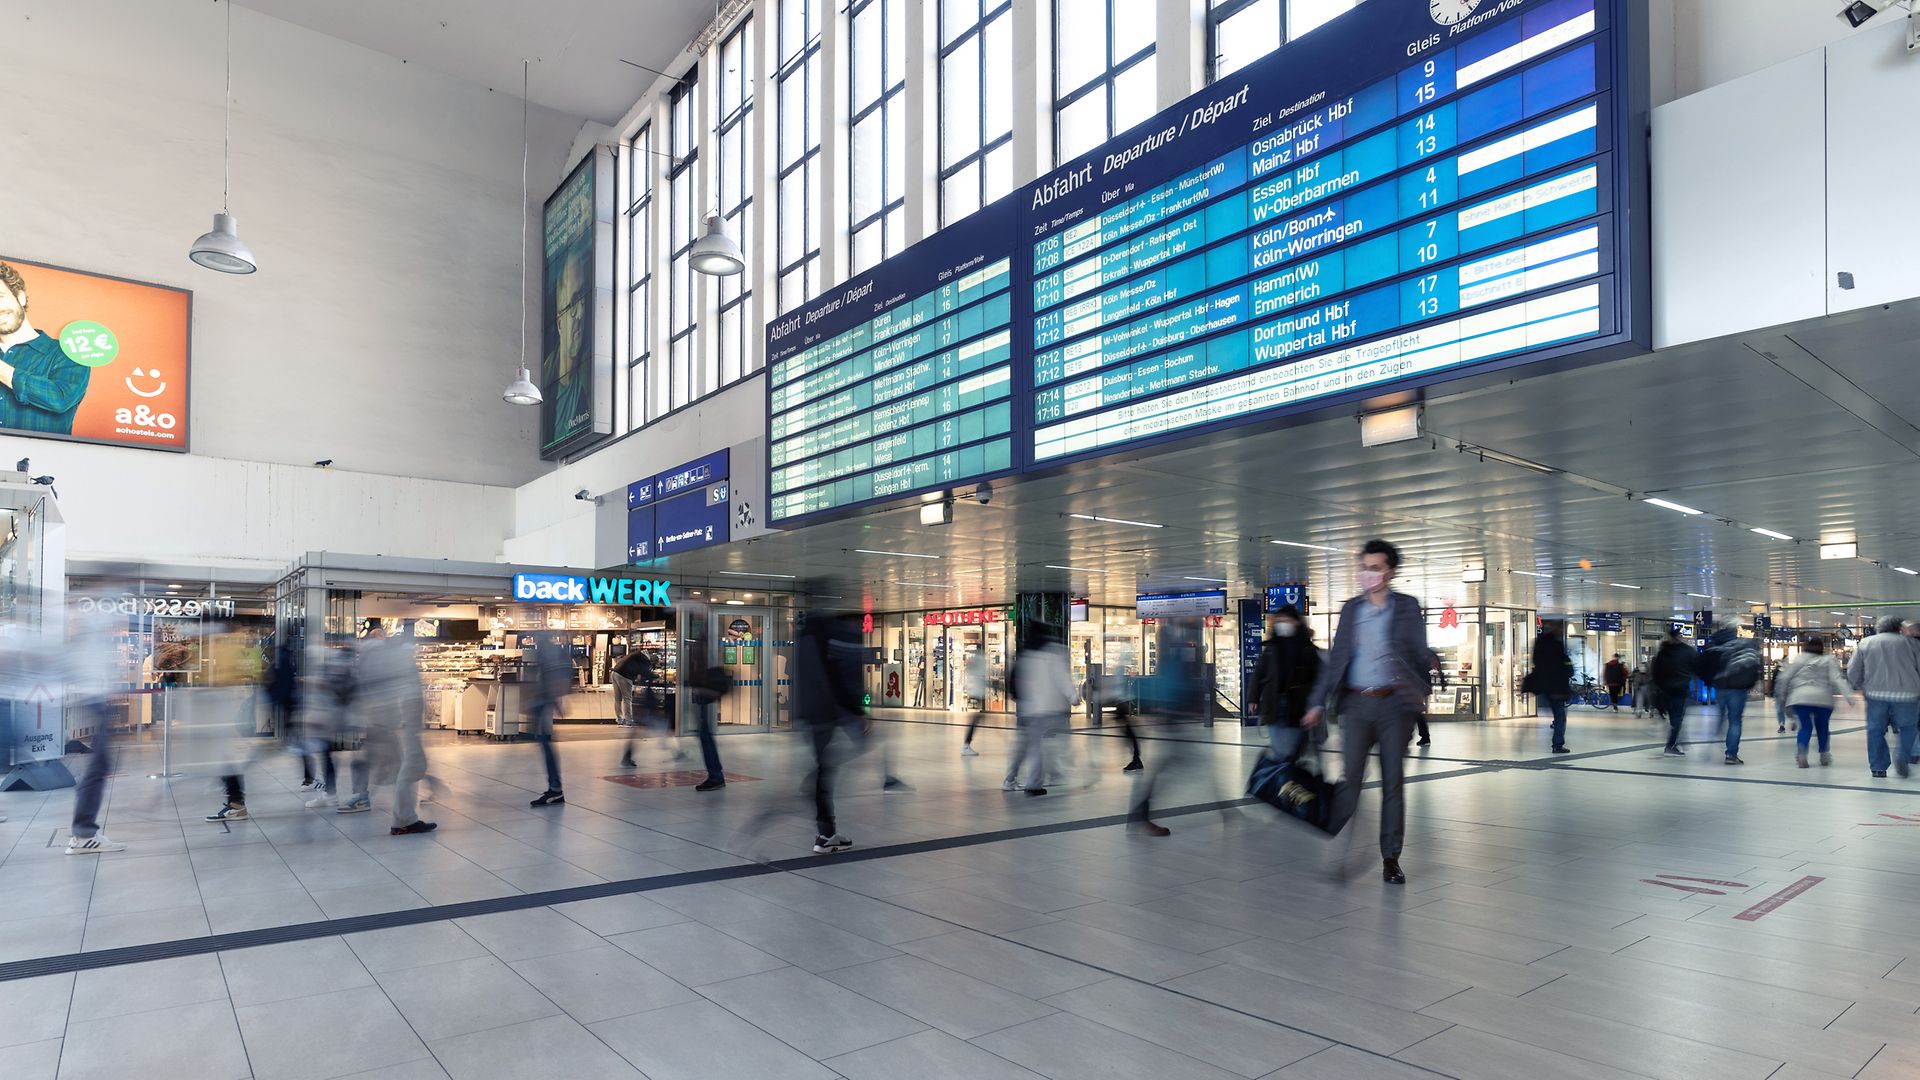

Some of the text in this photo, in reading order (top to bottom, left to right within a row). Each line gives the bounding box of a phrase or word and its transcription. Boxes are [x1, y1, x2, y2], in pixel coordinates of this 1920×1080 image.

[1406, 33, 1440, 58] Gleis
[1424, 59, 1434, 79] 9
[1414, 81, 1435, 105] 15
[1252, 90, 1325, 132] Ziel Destination
[1252, 97, 1352, 157] Osnabrück Hbf
[1415, 113, 1435, 136] 14
[1032, 163, 1091, 211] Abfahrt
[1102, 126, 1174, 175] Departure
[1191, 82, 1248, 129] Départ
[1253, 133, 1318, 176] Mainz Hbf
[1415, 135, 1436, 158] 13
[1253, 161, 1319, 203] Essen Hbf
[1425, 166, 1436, 185] 4
[1101, 187, 1120, 204] Über
[1102, 161, 1223, 226] Düsseldorf Essen Münster(W)
[1253, 169, 1359, 222] W-Oberbarmen
[1416, 188, 1437, 210] 11
[1103, 186, 1208, 242] Köln Messe/Dz Frankfurt(M)
[1034, 222, 1047, 236] Zeit
[1253, 213, 1322, 249] Köln/Bonn
[1426, 220, 1437, 238] 7
[1035, 235, 1058, 257] 17:06
[1103, 218, 1196, 266] D-Derendorf Ratingen Ost
[1253, 219, 1362, 268] Köln-Worringen
[1036, 251, 1058, 272] 17:08
[1103, 240, 1186, 282] Erkrath Wuppertal Hbf
[1417, 242, 1437, 264] 10
[938, 269, 952, 282] Gleis
[1036, 273, 1058, 294] 17:10
[1254, 259, 1318, 295] Hamm(W)
[1417, 273, 1438, 295] 17
[942, 285, 950, 298] 16
[1036, 289, 1058, 309] 17:10
[1103, 278, 1155, 305] Köln Messe/Dz
[1145, 293, 1161, 307] Köln
[1163, 286, 1176, 300] Hbf
[1255, 280, 1319, 314] Emmerich
[770, 279, 872, 342] Abfahrt Departure Départ
[942, 299, 950, 311] 16
[1417, 296, 1438, 317] 13
[942, 318, 950, 331] 11
[1036, 311, 1058, 331] 17:11
[1103, 293, 1239, 345] W-Vohwinkel Wuppertal Hbf Hagen
[1254, 299, 1349, 342] Dortmund Hbf
[64, 333, 112, 352] 12 €
[942, 332, 950, 345] 17
[1036, 327, 1059, 346] 17:12
[1103, 313, 1236, 362] Düsseldorf Duisburg Oberhausen
[1255, 318, 1356, 361] Wuppertal Hbf
[942, 352, 950, 365] 13
[1036, 349, 1059, 368] 17:12
[1318, 357, 1332, 369] Sie
[1355, 334, 1419, 360] Tragepflicht
[874, 372, 904, 389] Mettmann
[906, 363, 930, 378] Stadtw.
[942, 366, 950, 378] 14
[1036, 365, 1059, 383] 17:12
[1104, 353, 1193, 385] Duisburg Essen Bochum
[1150, 373, 1185, 389] Mettmann
[1189, 364, 1219, 379] Stadtw.
[1283, 380, 1319, 398] Bahnhof
[1323, 375, 1340, 388] und
[1357, 369, 1375, 380] den
[1379, 360, 1412, 375] Zügen
[874, 383, 902, 402] Dortmund
[904, 378, 915, 391] Hbf
[943, 386, 950, 398] 11
[1036, 387, 1059, 405] 17:14
[115, 404, 176, 429] a&o
[874, 395, 928, 420] Remscheid-Lennep
[942, 400, 950, 412] 16
[1036, 403, 1059, 421] 17:16
[874, 419, 896, 433] Koblenz
[899, 412, 909, 425] Hbf
[942, 420, 950, 431] 12
[116, 428, 174, 439] aohostels.com
[874, 432, 906, 451] Langenfeld
[942, 433, 950, 445] 17
[874, 449, 892, 463] Wesel
[942, 453, 950, 465] 14
[943, 467, 951, 478] 11
[713, 488, 719, 502] S
[874, 476, 910, 494] Solingen Hbf
[518, 574, 671, 607] back WERK
[924, 610, 999, 626] APOTHEKE
[1696, 611, 1704, 622] 4
[1756, 617, 1763, 627] 5
[24, 734, 54, 744] Ausgang
[31, 744, 46, 753] Exit
